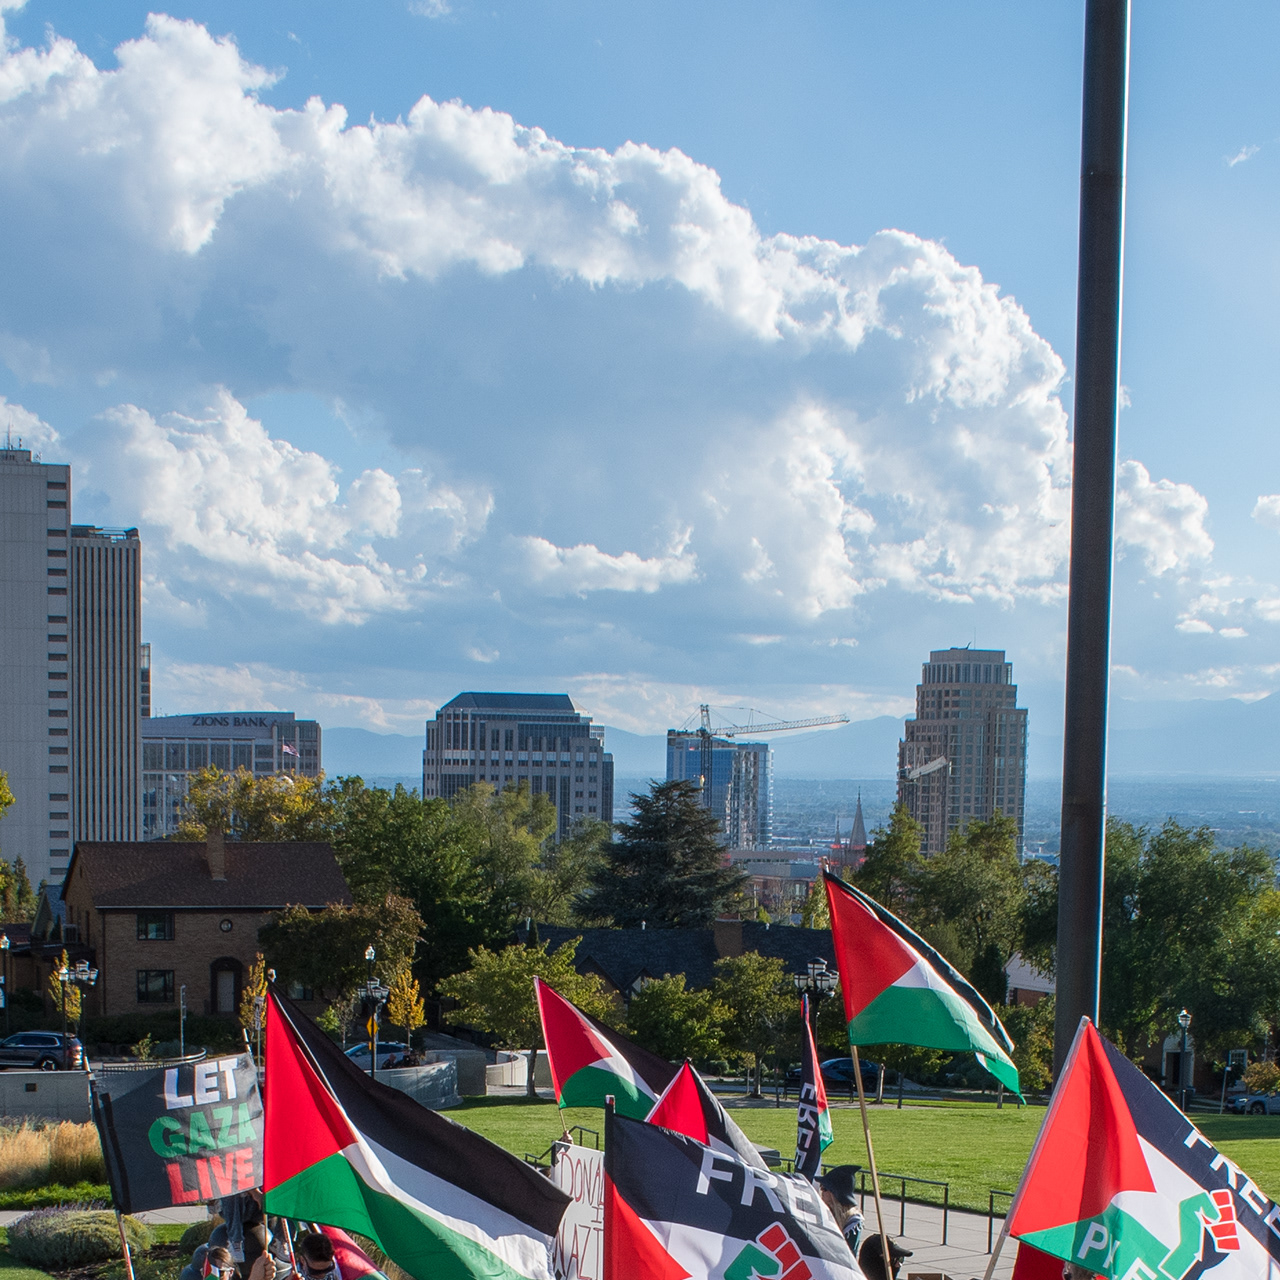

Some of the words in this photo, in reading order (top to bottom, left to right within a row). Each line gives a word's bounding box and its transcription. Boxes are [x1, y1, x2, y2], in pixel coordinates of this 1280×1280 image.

[192, 716, 229, 727] ZIONS
[233, 717, 268, 727] BANK
[164, 1058, 238, 1110] LET
[148, 1102, 257, 1158] GAZA
[166, 1147, 255, 1204] LIVE
[559, 1151, 604, 1206] DONAL
[696, 1146, 833, 1224] FRE
